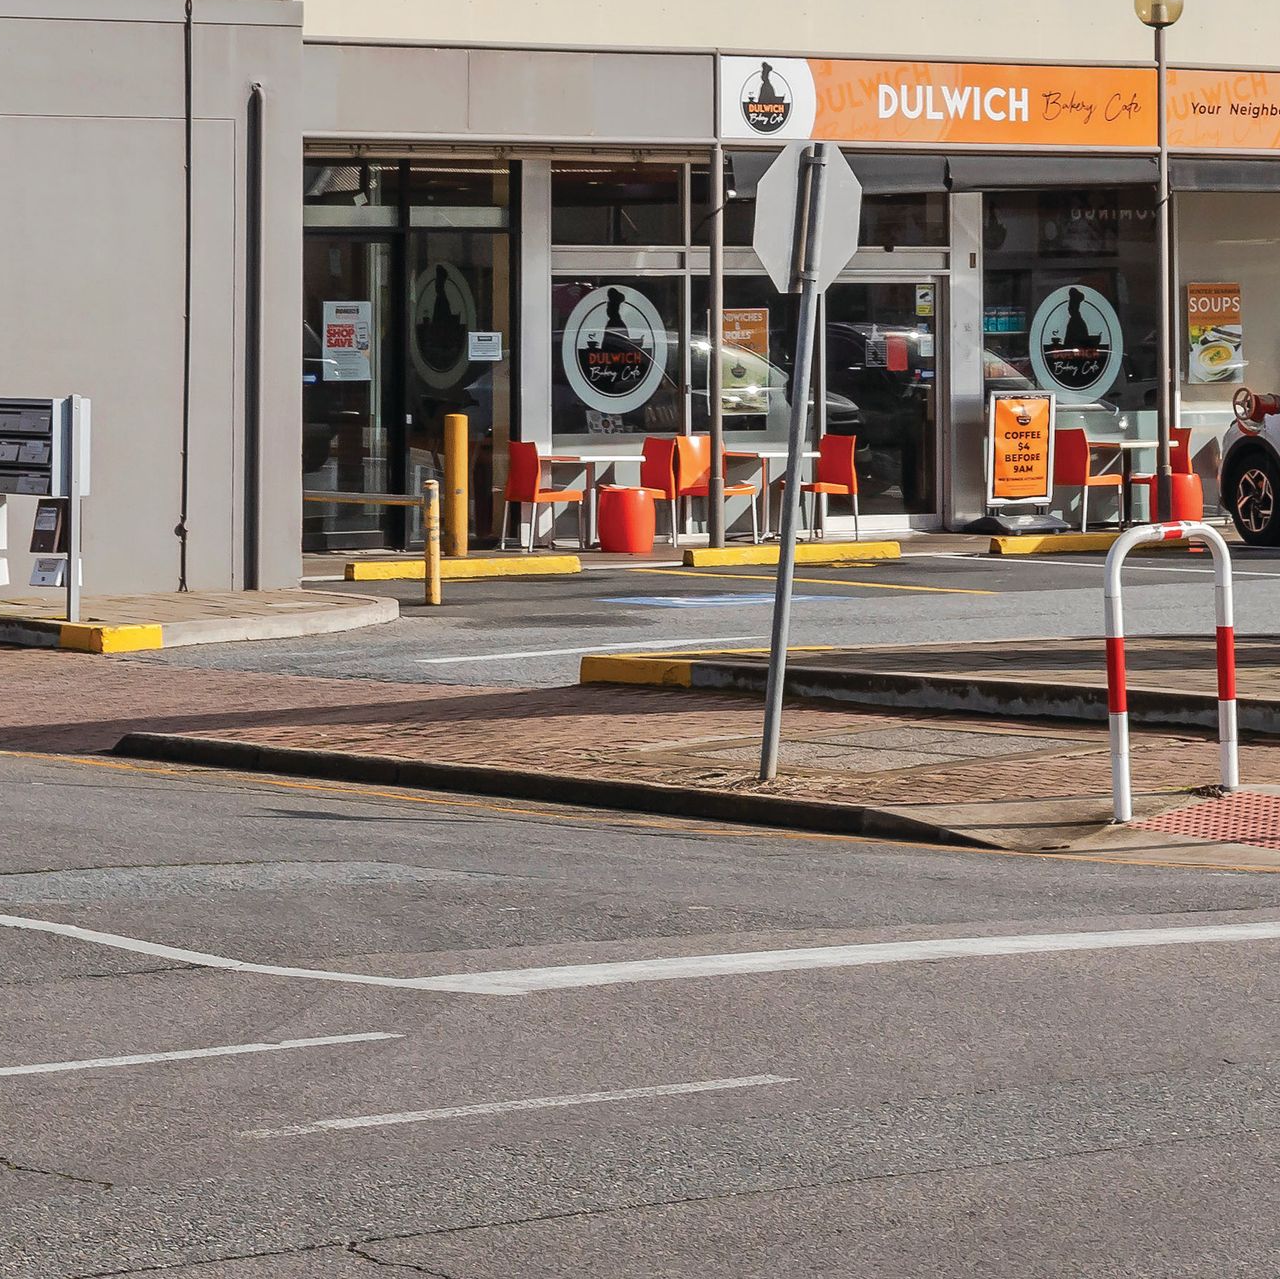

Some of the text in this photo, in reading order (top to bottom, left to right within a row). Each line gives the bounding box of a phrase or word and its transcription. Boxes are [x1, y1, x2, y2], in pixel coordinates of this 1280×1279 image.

[748, 103, 784, 114] DULWICH
[878, 84, 1029, 122] DULWICH
[1042, 91, 1096, 124] Bakery
[1191, 102, 1222, 115] Your
[1189, 297, 1240, 312] SOUPS
[327, 329, 355, 338] SHOP
[327, 338, 353, 348] SAVE
[589, 352, 641, 364] DULWICH
[1004, 431, 1041, 439] COFFEE
[1018, 442, 1030, 451] $4
[1005, 453, 1040, 462] BEFORE
[1013, 465, 1033, 473] 9AM
